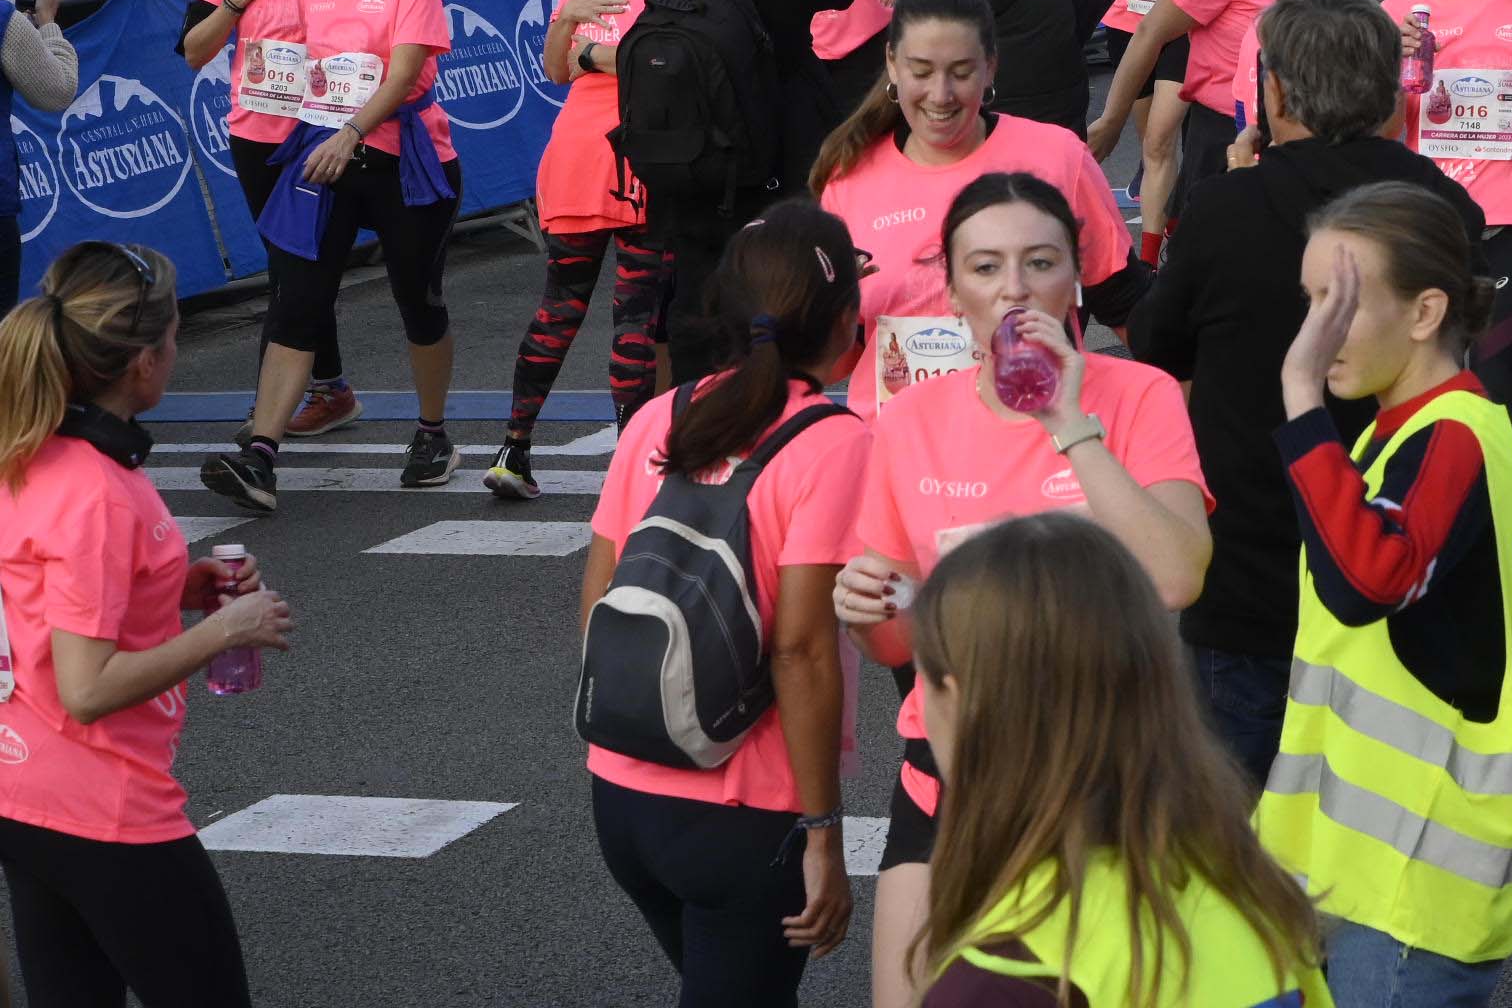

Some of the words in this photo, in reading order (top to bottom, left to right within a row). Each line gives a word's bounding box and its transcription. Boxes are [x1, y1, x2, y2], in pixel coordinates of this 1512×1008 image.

[268, 69, 295, 83] 016
[435, 58, 521, 103] ASTURIANA
[270, 83, 288, 92] 8203
[329, 80, 350, 94] 016
[1454, 84, 1492, 94] ASTURIANA
[1455, 105, 1488, 118] 016
[1460, 121, 1481, 130] 7148
[1428, 144, 1459, 153] OYSHO
[73, 131, 183, 192] ASTURIANA
[873, 207, 926, 232] OYSHO
[910, 340, 962, 351] ASTURIANA
[919, 476, 988, 498] OYSHO
